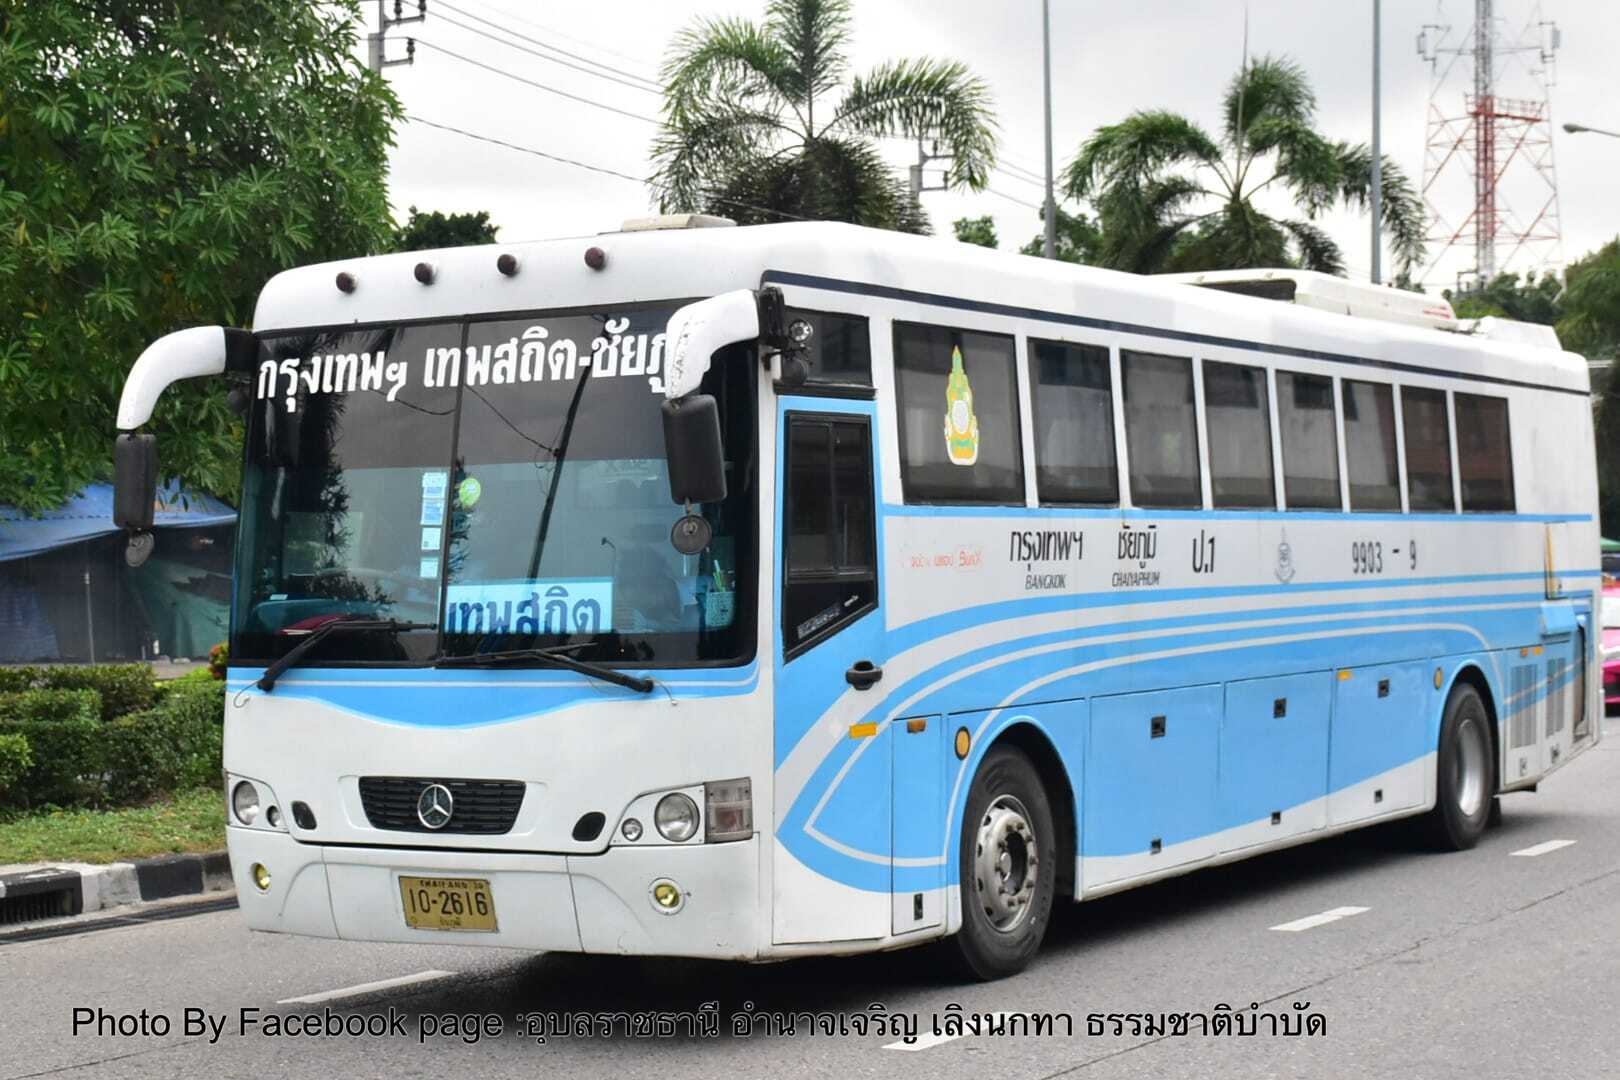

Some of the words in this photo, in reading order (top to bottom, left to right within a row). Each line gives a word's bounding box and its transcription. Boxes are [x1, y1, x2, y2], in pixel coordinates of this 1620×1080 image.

[257, 351, 408, 413] กรุงเทพฯ
[424, 317, 667, 393] เทพสถิต-ชัยภู
[1009, 530, 1084, 572] กรุงเทพฯ
[1117, 524, 1157, 569] ชัยภูมิ
[1192, 529, 1216, 573] ป.1
[1351, 541, 1384, 574] 9903
[1409, 540, 1417, 570] 9
[1025, 573, 1067, 590] BANGKOK
[409, 888, 489, 916] 10-2616
